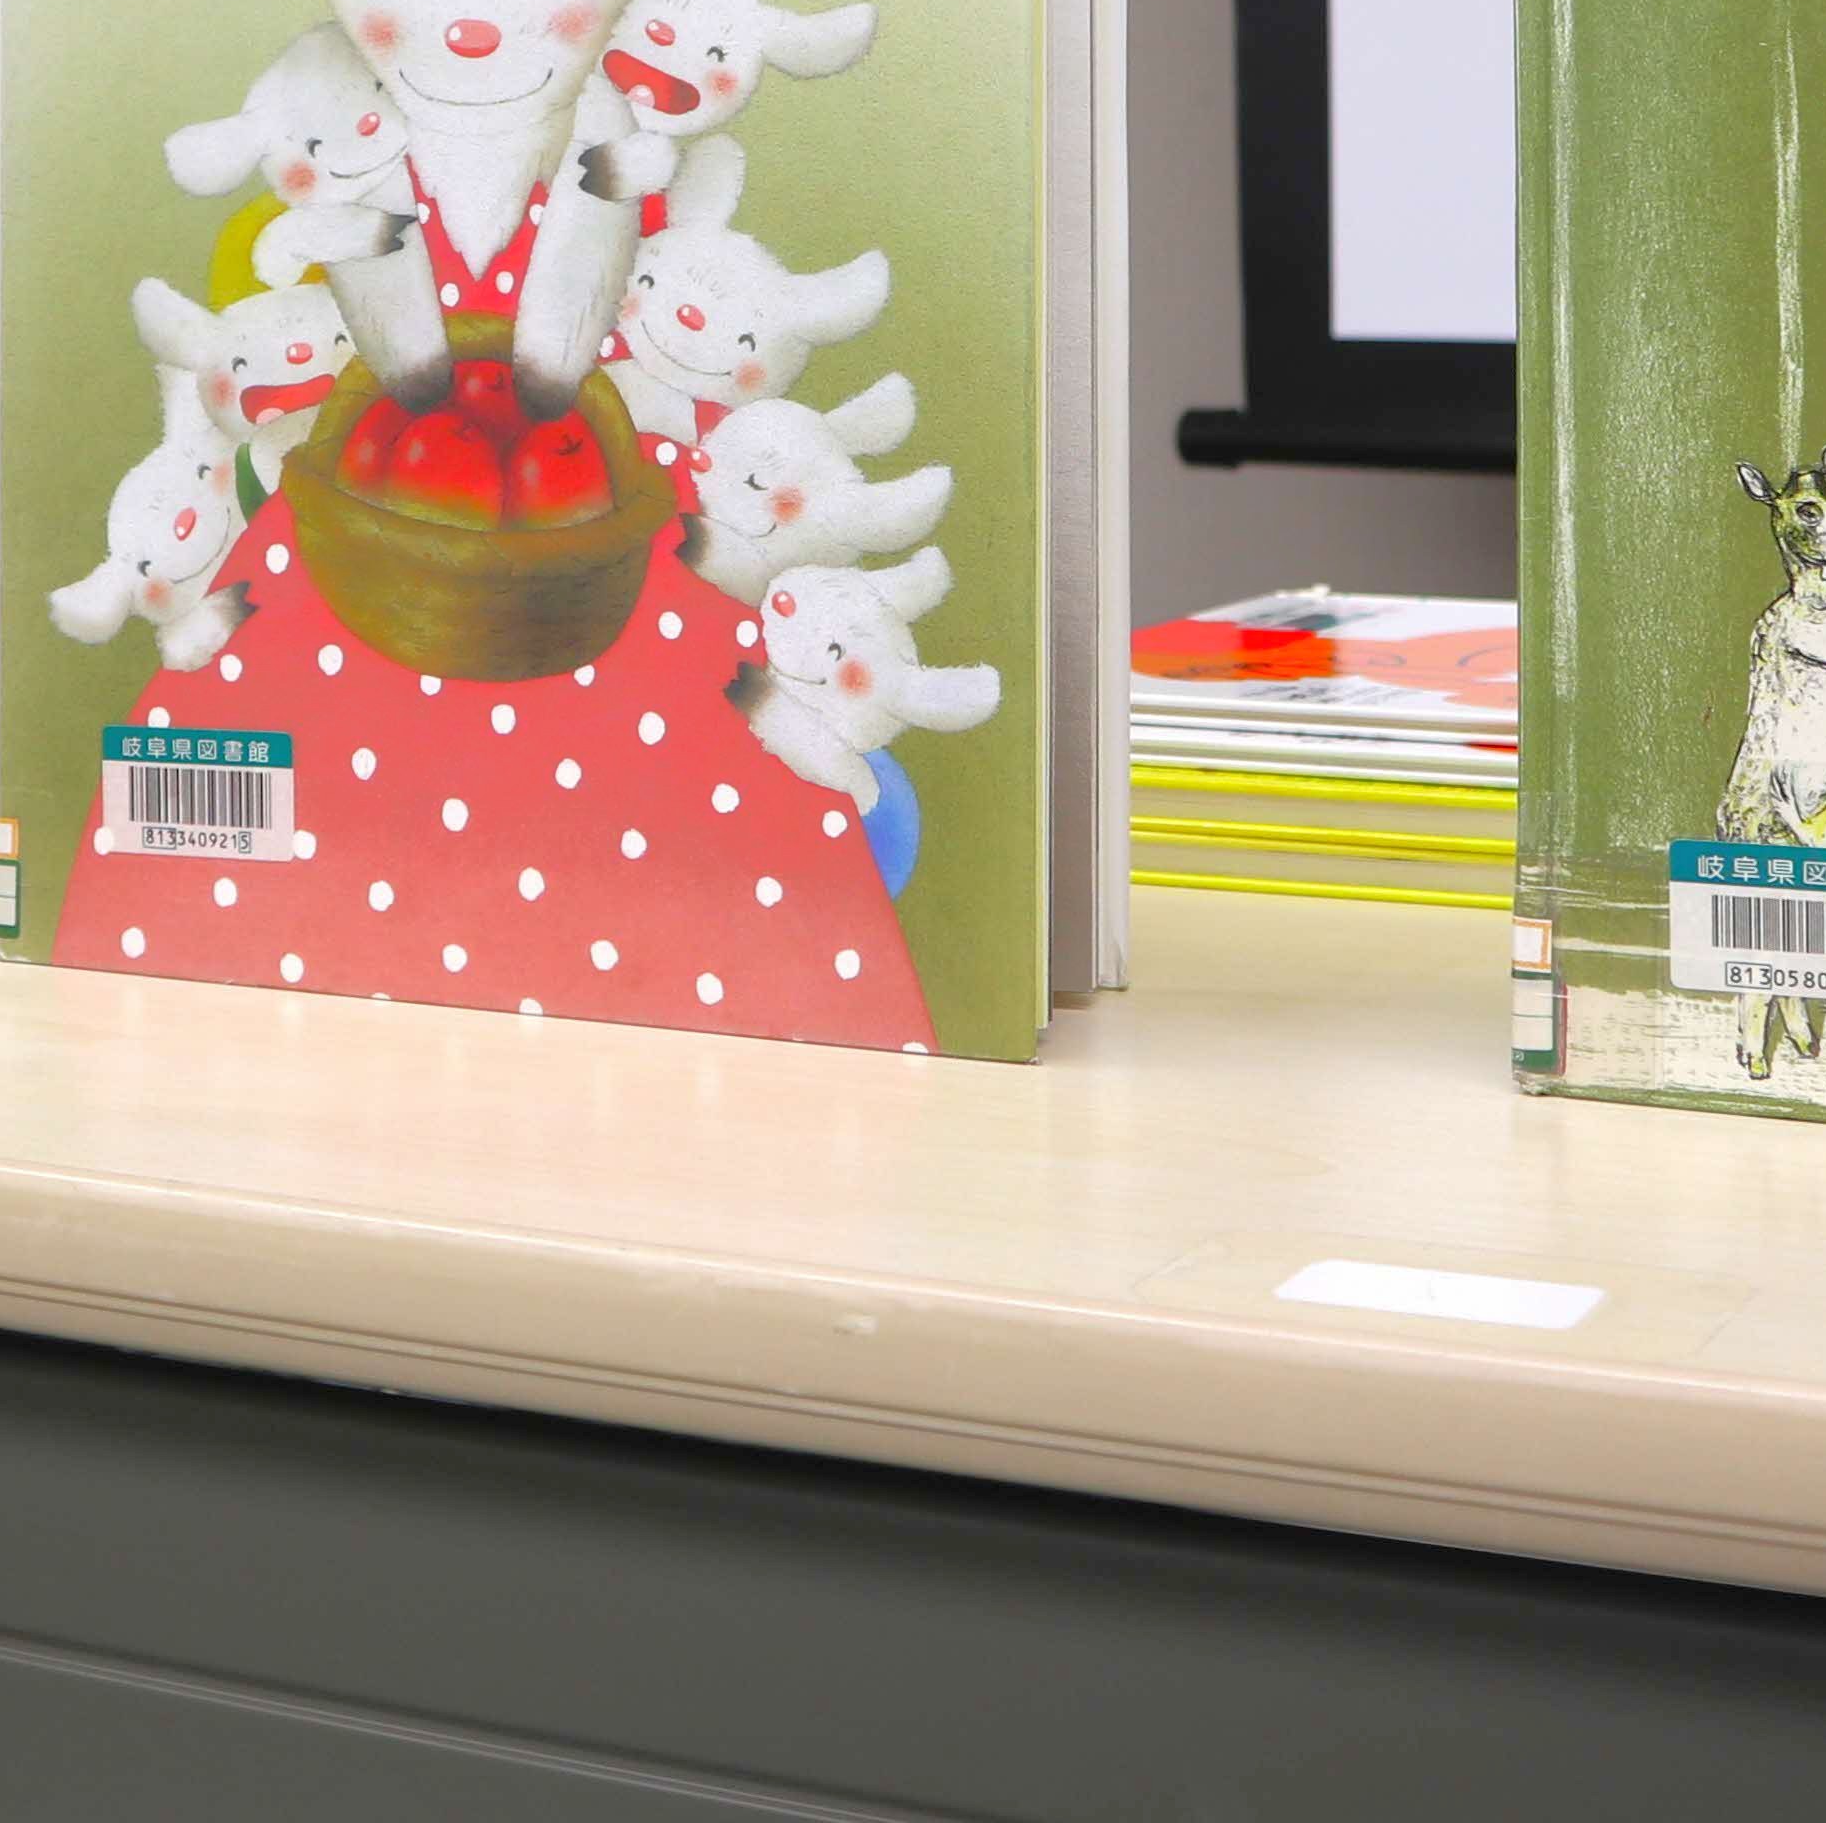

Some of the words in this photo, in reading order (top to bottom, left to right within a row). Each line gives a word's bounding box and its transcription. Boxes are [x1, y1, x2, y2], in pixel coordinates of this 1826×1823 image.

[121, 734, 270, 764] 岐阜県図書館
[145, 828, 249, 850] 8133409215
